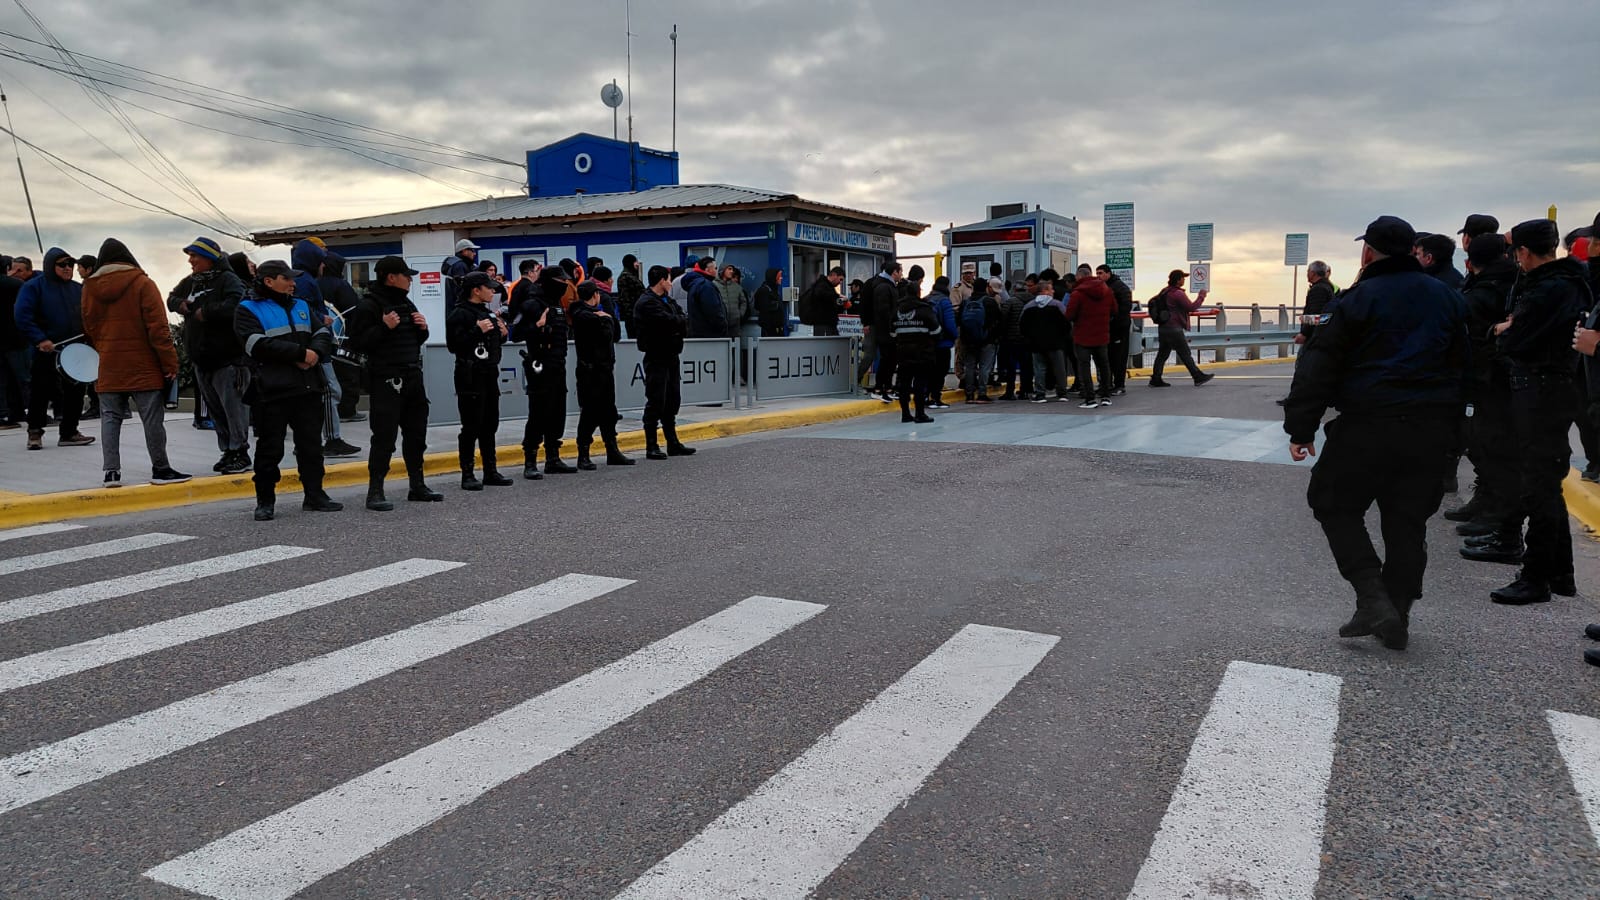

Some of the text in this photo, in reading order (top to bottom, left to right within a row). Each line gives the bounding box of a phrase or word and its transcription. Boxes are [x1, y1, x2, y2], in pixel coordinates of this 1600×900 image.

[803, 224, 868, 248] PREFECTURA NAVAL ARGENTINA
